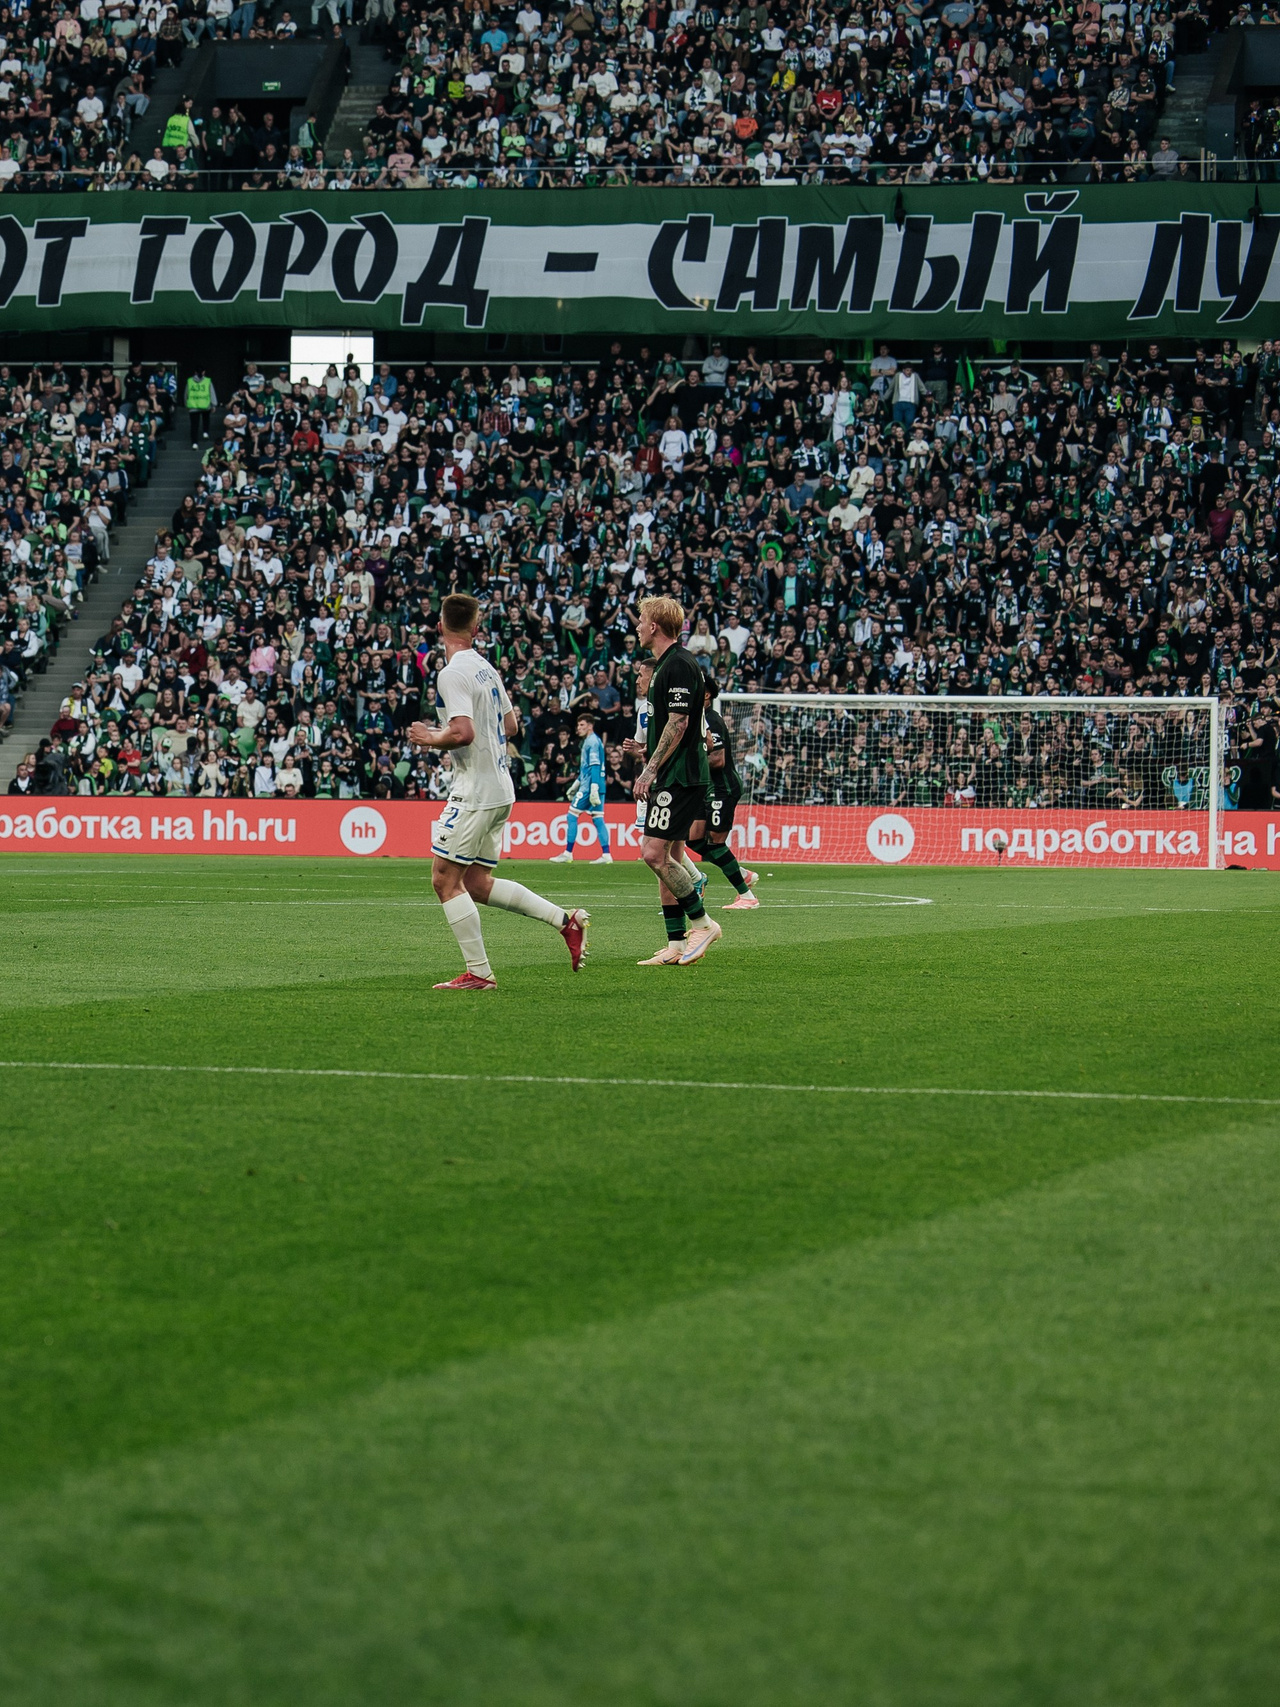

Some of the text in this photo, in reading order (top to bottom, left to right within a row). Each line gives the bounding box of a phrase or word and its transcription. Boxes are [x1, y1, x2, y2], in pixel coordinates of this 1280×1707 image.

[129, 209, 490, 329] ГОРОД
[647, 190, 1083, 314] САМЫЙ
[1126, 212, 1280, 324] ЛУ
[150, 816, 195, 841] на
[202, 809, 296, 843] hh.ru
[444, 806, 459, 829] 2
[648, 805, 671, 830] 88
[711, 810, 721, 826] 6
[351, 821, 376, 839] hh
[878, 829, 904, 846] hh
[961, 821, 1201, 861] подработка
